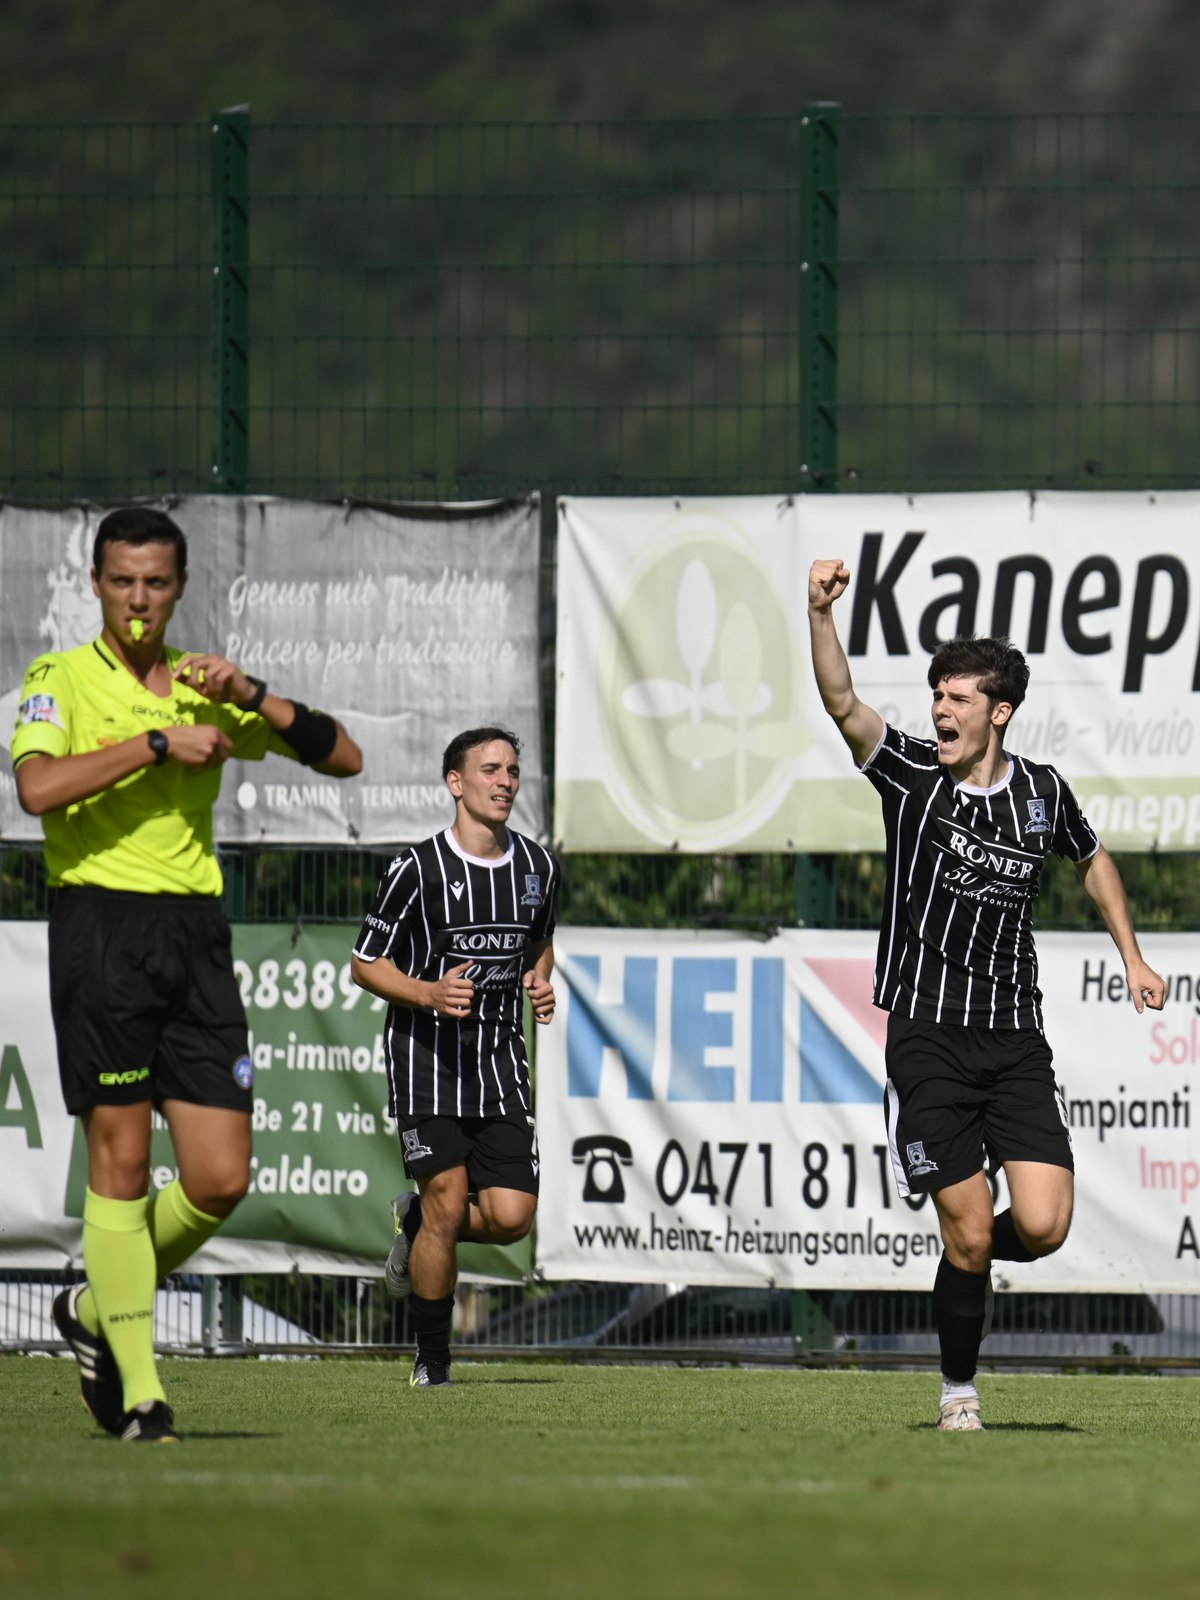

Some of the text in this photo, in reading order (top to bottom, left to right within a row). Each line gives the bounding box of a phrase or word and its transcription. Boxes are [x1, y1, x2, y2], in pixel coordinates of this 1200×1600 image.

[229, 573, 319, 617] Genuss
[225, 629, 321, 665] Piacere
[321, 637, 371, 682] per
[1104, 712, 1194, 757] vivaio
[264, 784, 341, 807] TRAMIN
[361, 784, 449, 807] TERMENO
[950, 831, 1034, 879] RONER
[452, 933, 526, 951] RONER
[291, 1101, 323, 1132] 21
[336, 1102, 376, 1135] via
[655, 1139, 773, 1209] 0471
